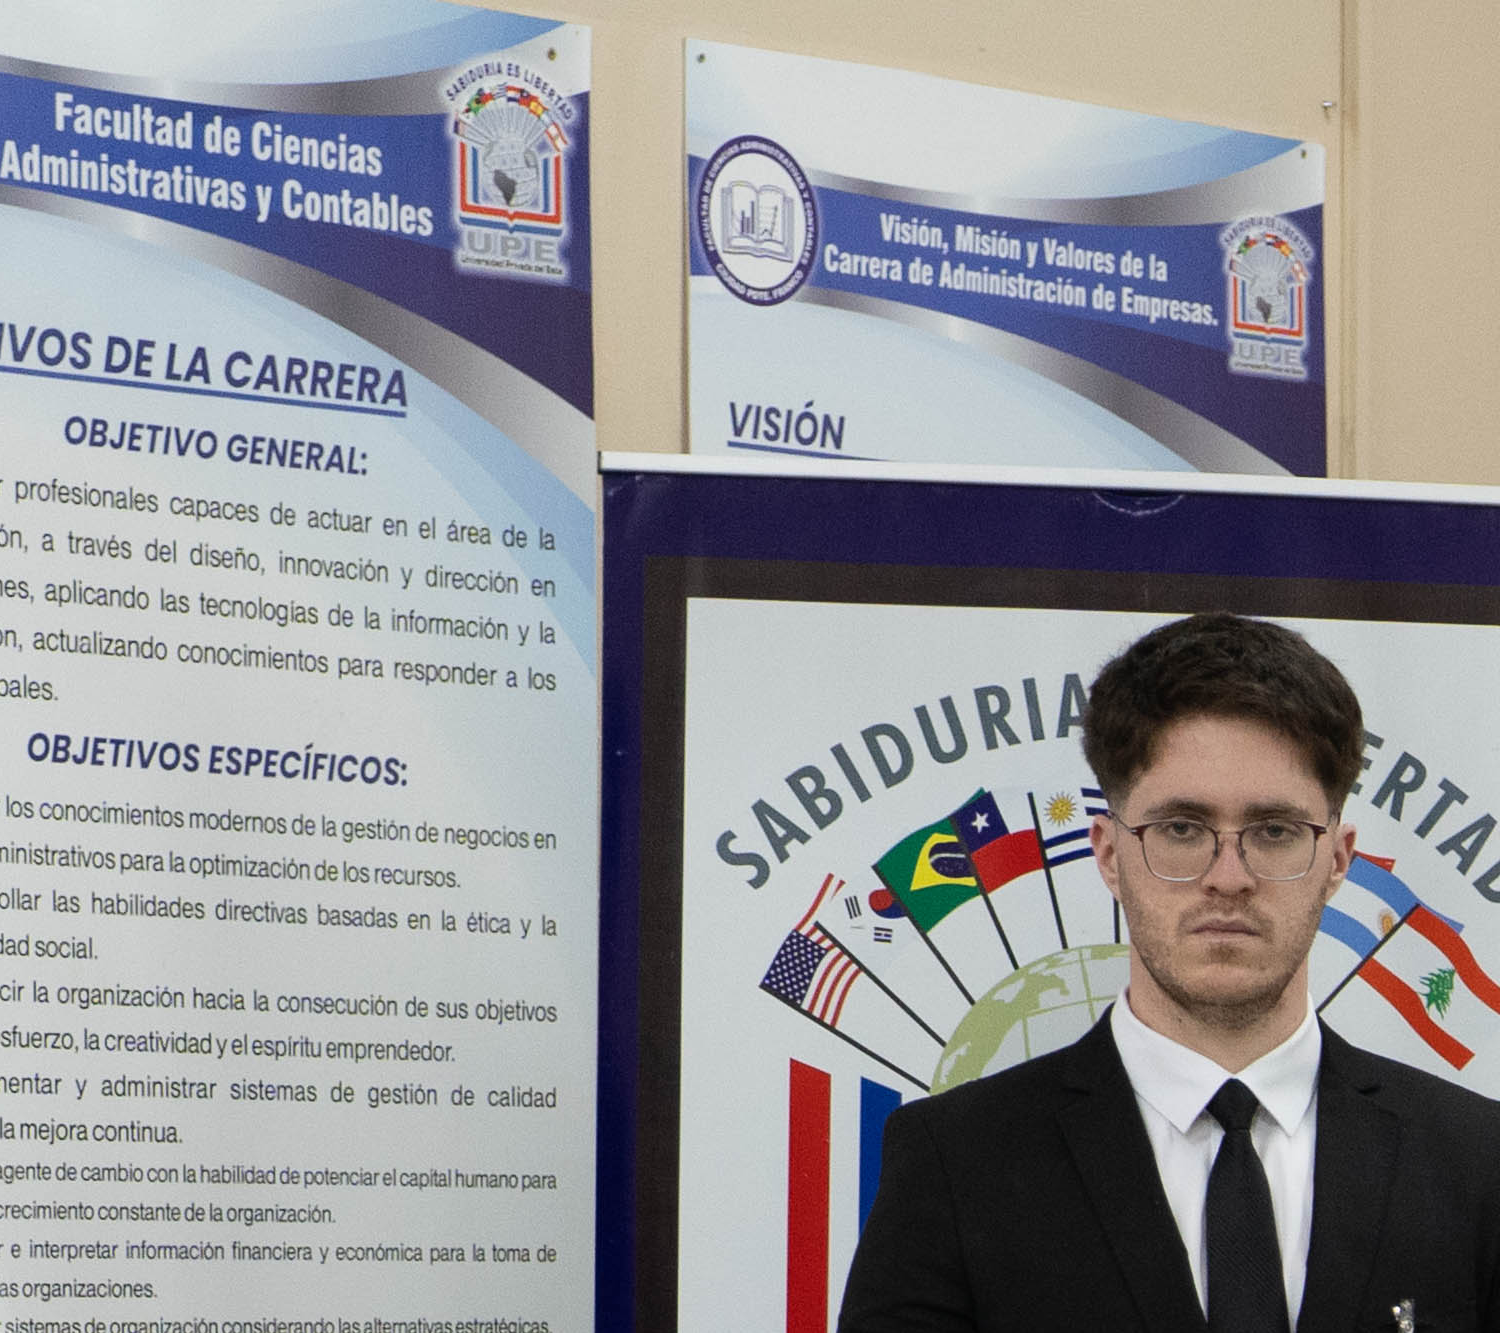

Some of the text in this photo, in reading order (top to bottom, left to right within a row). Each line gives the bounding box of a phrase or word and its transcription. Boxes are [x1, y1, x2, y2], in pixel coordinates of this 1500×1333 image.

[55, 92, 382, 176] Facultad de Ciencias
[0, 140, 433, 236] Administrativas y Contables
[880, 213, 1167, 281] Visión, Misión y Valores de la
[824, 244, 1218, 326] Carrera de Administración de Empresas.
[104, 336, 155, 377] DE
[165, 343, 210, 384] LA
[225, 351, 407, 407] CARRERA
[65, 416, 367, 475] OBJETIVO GENERAL:
[730, 401, 845, 450] VISIÓN
[28, 733, 407, 786] OBJETIVOS ESPECÍFICOS:
[717, 672, 1088, 890] SABIDURIA
[53, 890, 80, 913] las
[92, 892, 205, 919] habilidades
[215, 899, 307, 924] directivas
[318, 904, 398, 929] basadas
[407, 913, 430, 930] en
[442, 910, 457, 931] la
[467, 912, 511, 934] ética
[520, 919, 531, 939] y
[542, 915, 557, 936] la
